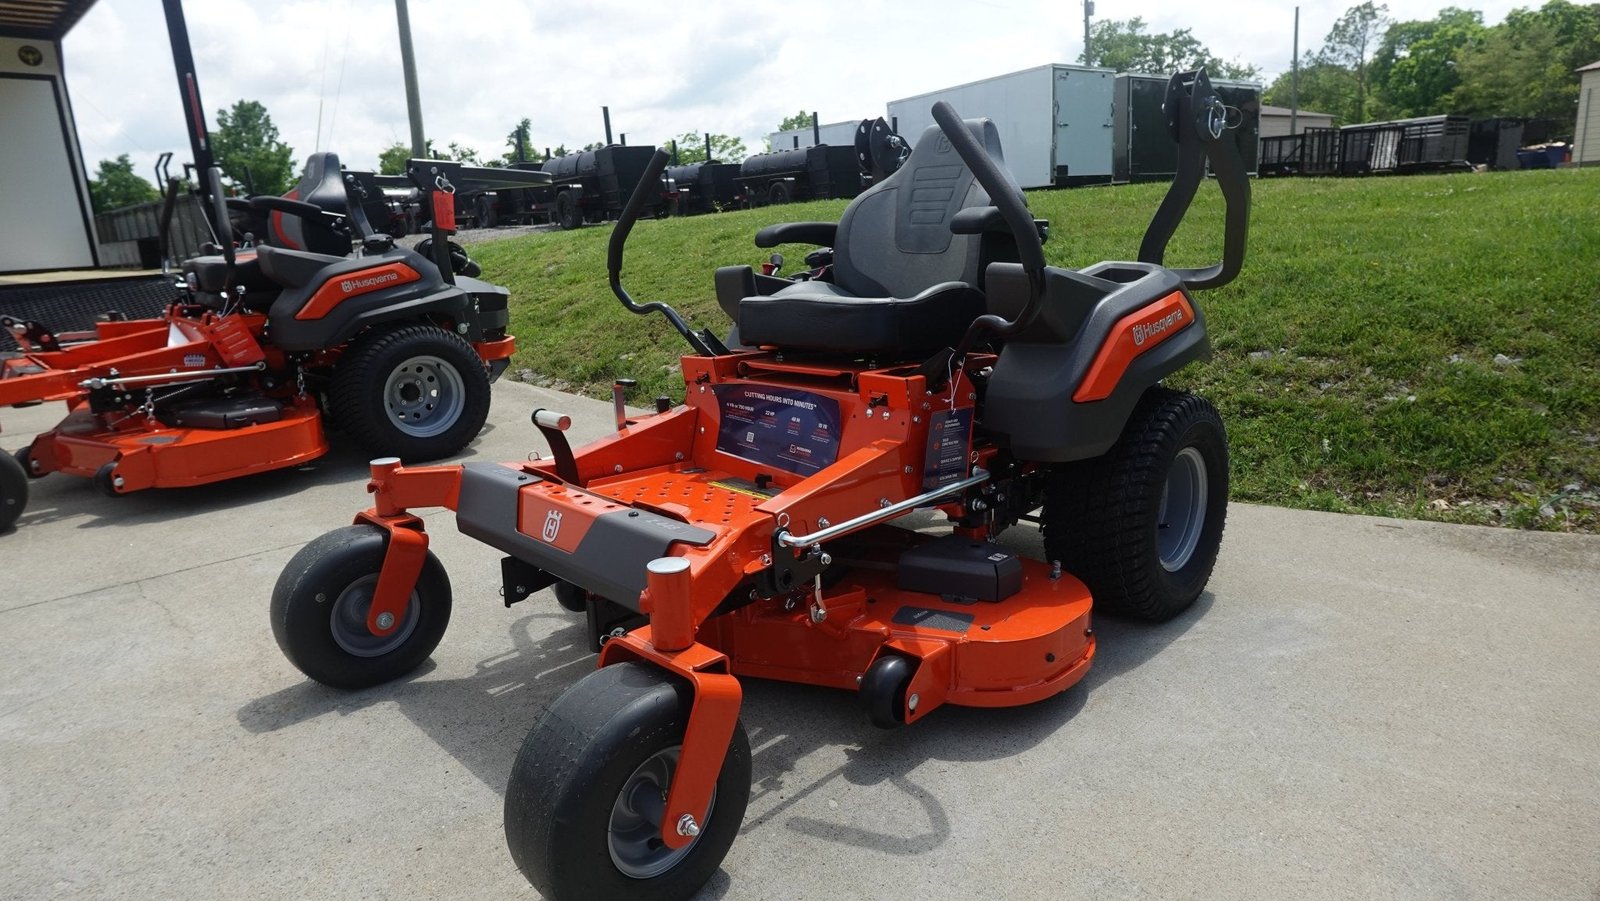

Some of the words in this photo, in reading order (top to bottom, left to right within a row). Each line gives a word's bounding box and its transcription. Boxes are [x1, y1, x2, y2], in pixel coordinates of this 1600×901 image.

[352, 272, 398, 289] Husqvarna
[1143, 309, 1183, 339] Husqvarna
[744, 391, 766, 400] CUTTING
[766, 395, 782, 403] HOURS
[782, 398, 794, 406] INTO
